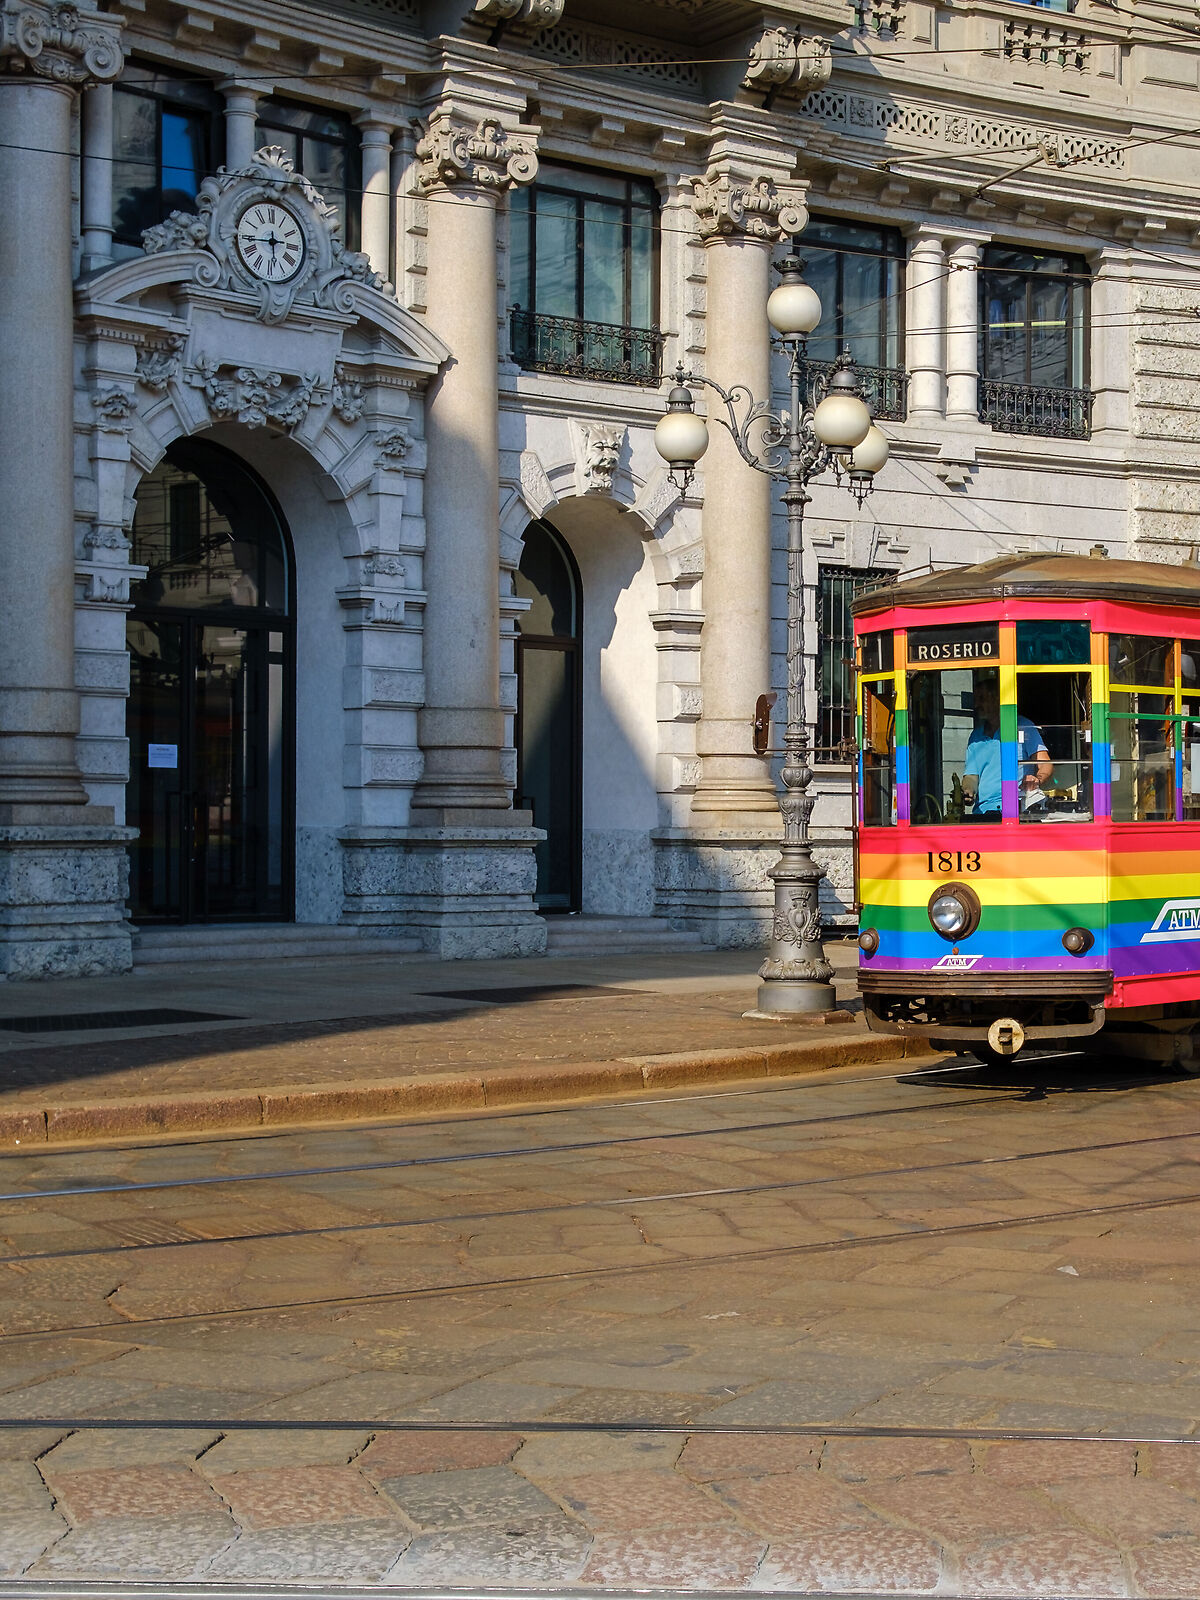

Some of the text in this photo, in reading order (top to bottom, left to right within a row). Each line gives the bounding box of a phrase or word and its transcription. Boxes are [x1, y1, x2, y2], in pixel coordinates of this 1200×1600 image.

[918, 641, 992, 660] ROSERIO
[927, 850, 982, 873] 1813
[946, 958, 967, 966] ATM
